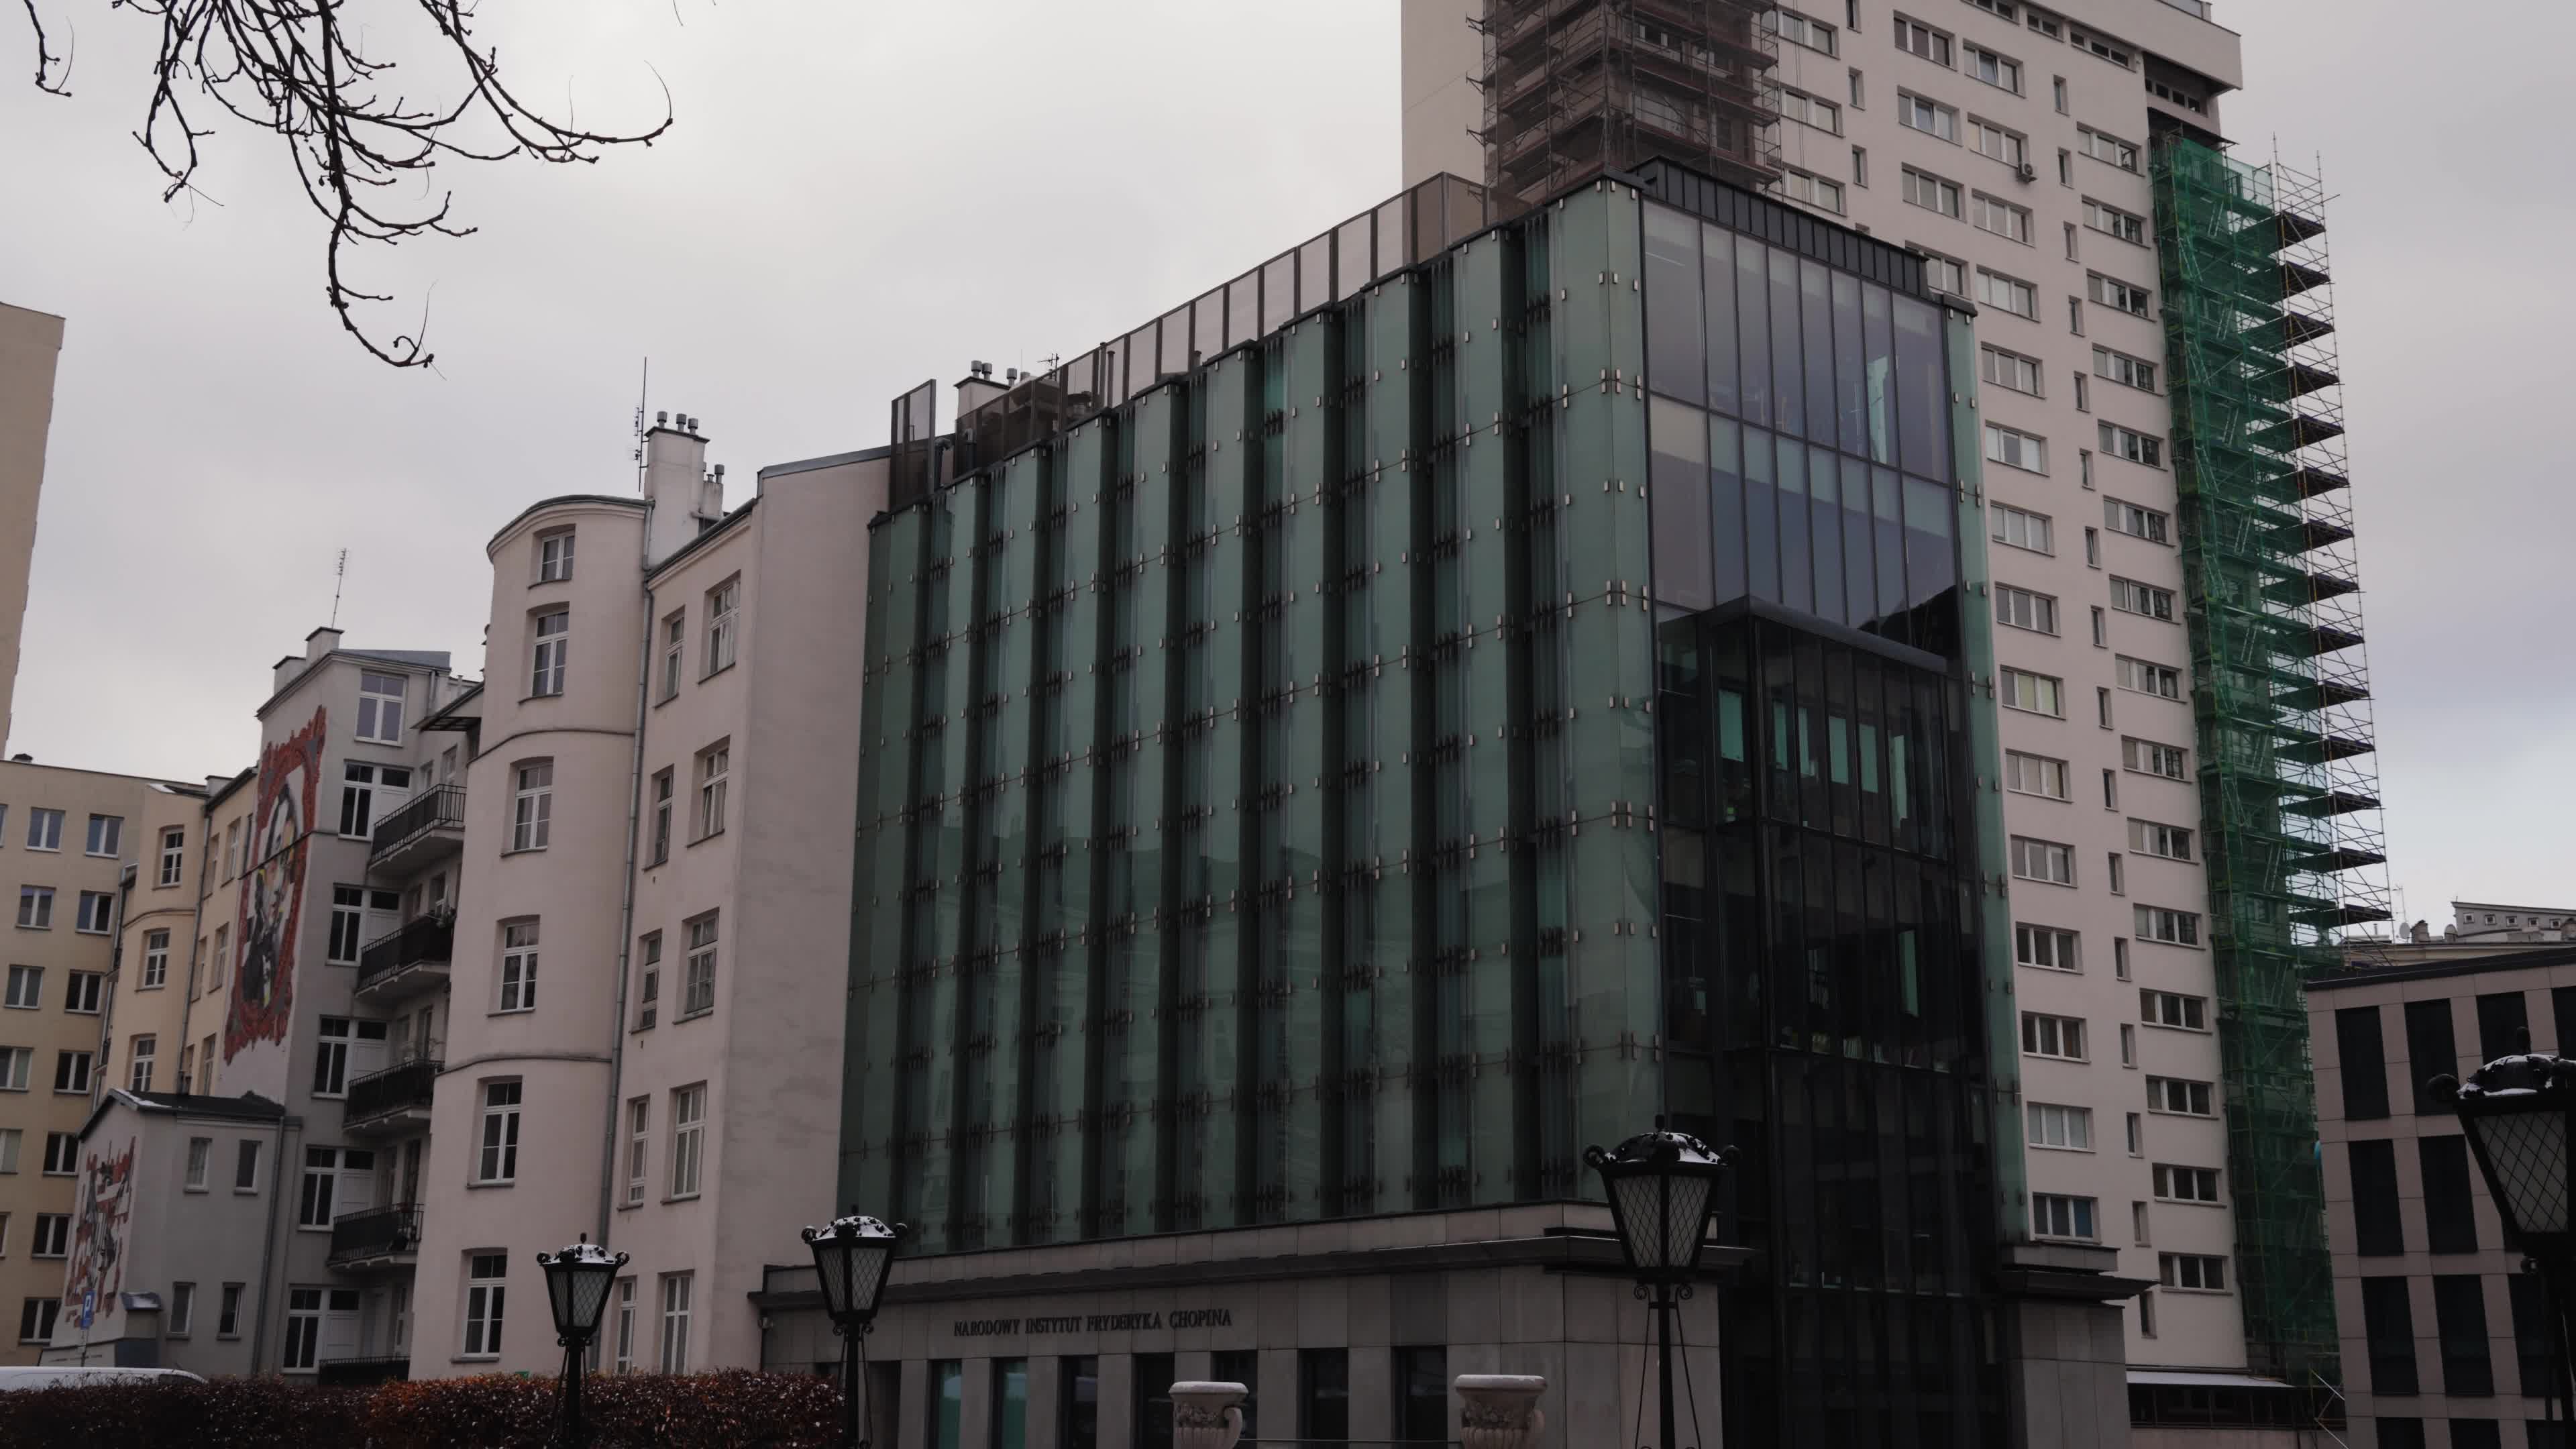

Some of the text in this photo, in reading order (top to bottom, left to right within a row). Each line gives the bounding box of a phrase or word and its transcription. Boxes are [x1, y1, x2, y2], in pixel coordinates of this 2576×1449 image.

[84, 1295, 92, 1318] P
[953, 1309, 1232, 1337] NARODOWY INSTYTUT FRYDERYKA CHOPINA
